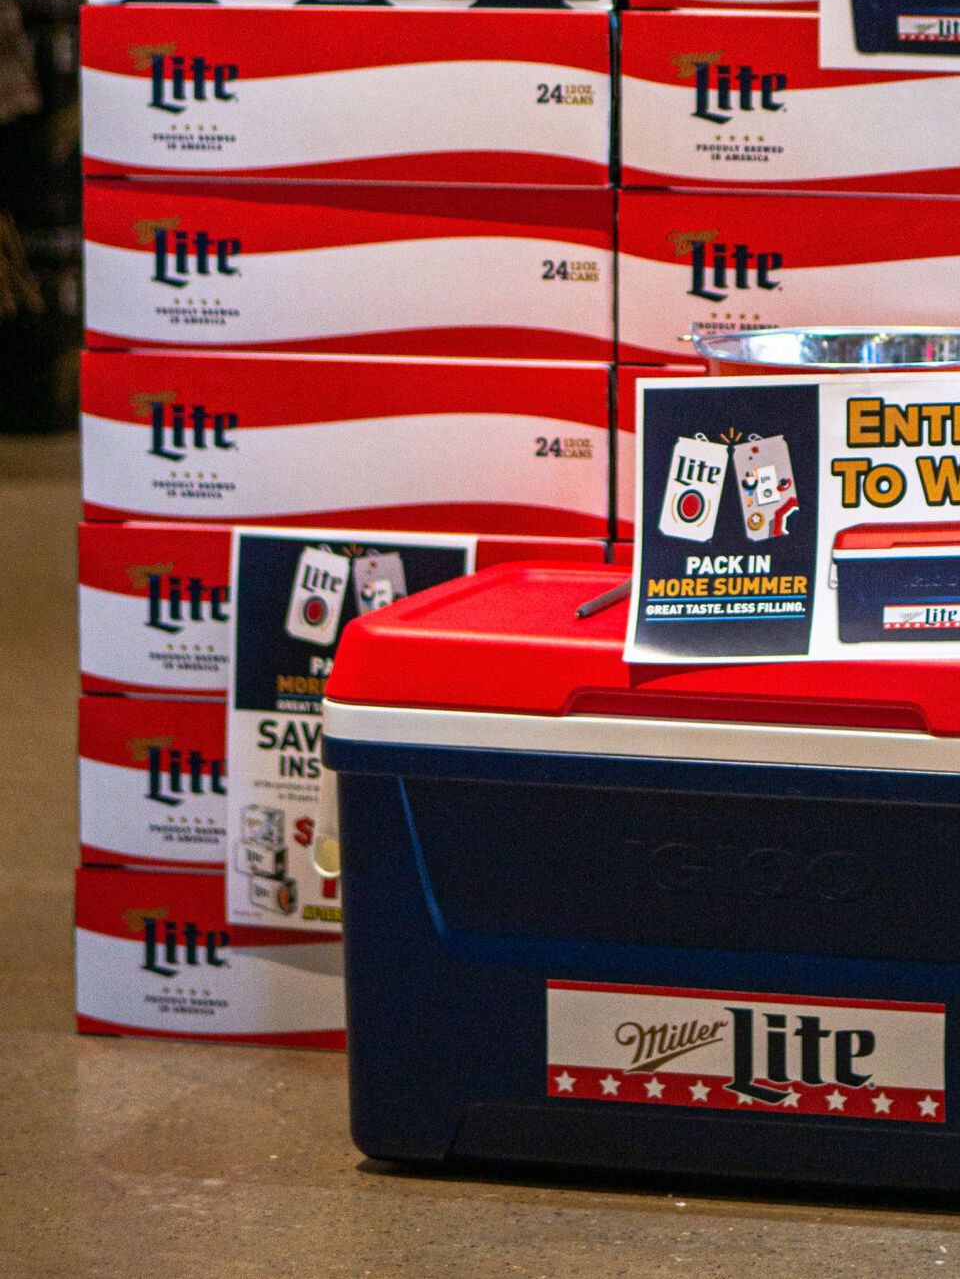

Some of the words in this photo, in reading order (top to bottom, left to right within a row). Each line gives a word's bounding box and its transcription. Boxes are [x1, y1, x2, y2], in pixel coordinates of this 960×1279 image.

[148, 51, 237, 115] Lite
[536, 83, 563, 104] 24
[691, 60, 786, 126] Lite
[151, 226, 241, 290] Lite
[542, 260, 569, 280] 24
[686, 239, 781, 304] Lite
[147, 399, 237, 463] Lite
[535, 437, 562, 458] 24
[673, 454, 722, 487] Lite
[831, 456, 907, 509] TO
[300, 563, 344, 595] Lite
[685, 555, 745, 576] PACK
[748, 554, 772, 574] IN
[646, 577, 709, 598] MORE
[712, 575, 808, 596] SUMMER
[144, 572, 231, 635] Lite
[645, 603, 684, 615] GREAT
[685, 603, 724, 615] TASTE.
[726, 602, 756, 614] LESS
[757, 601, 806, 614] FILLING.
[924, 606, 958, 627] Lite
[257, 720, 323, 753] SAV
[140, 915, 229, 979] Lite
[615, 1016, 729, 1073] Miller
[723, 1006, 877, 1105] Lite
